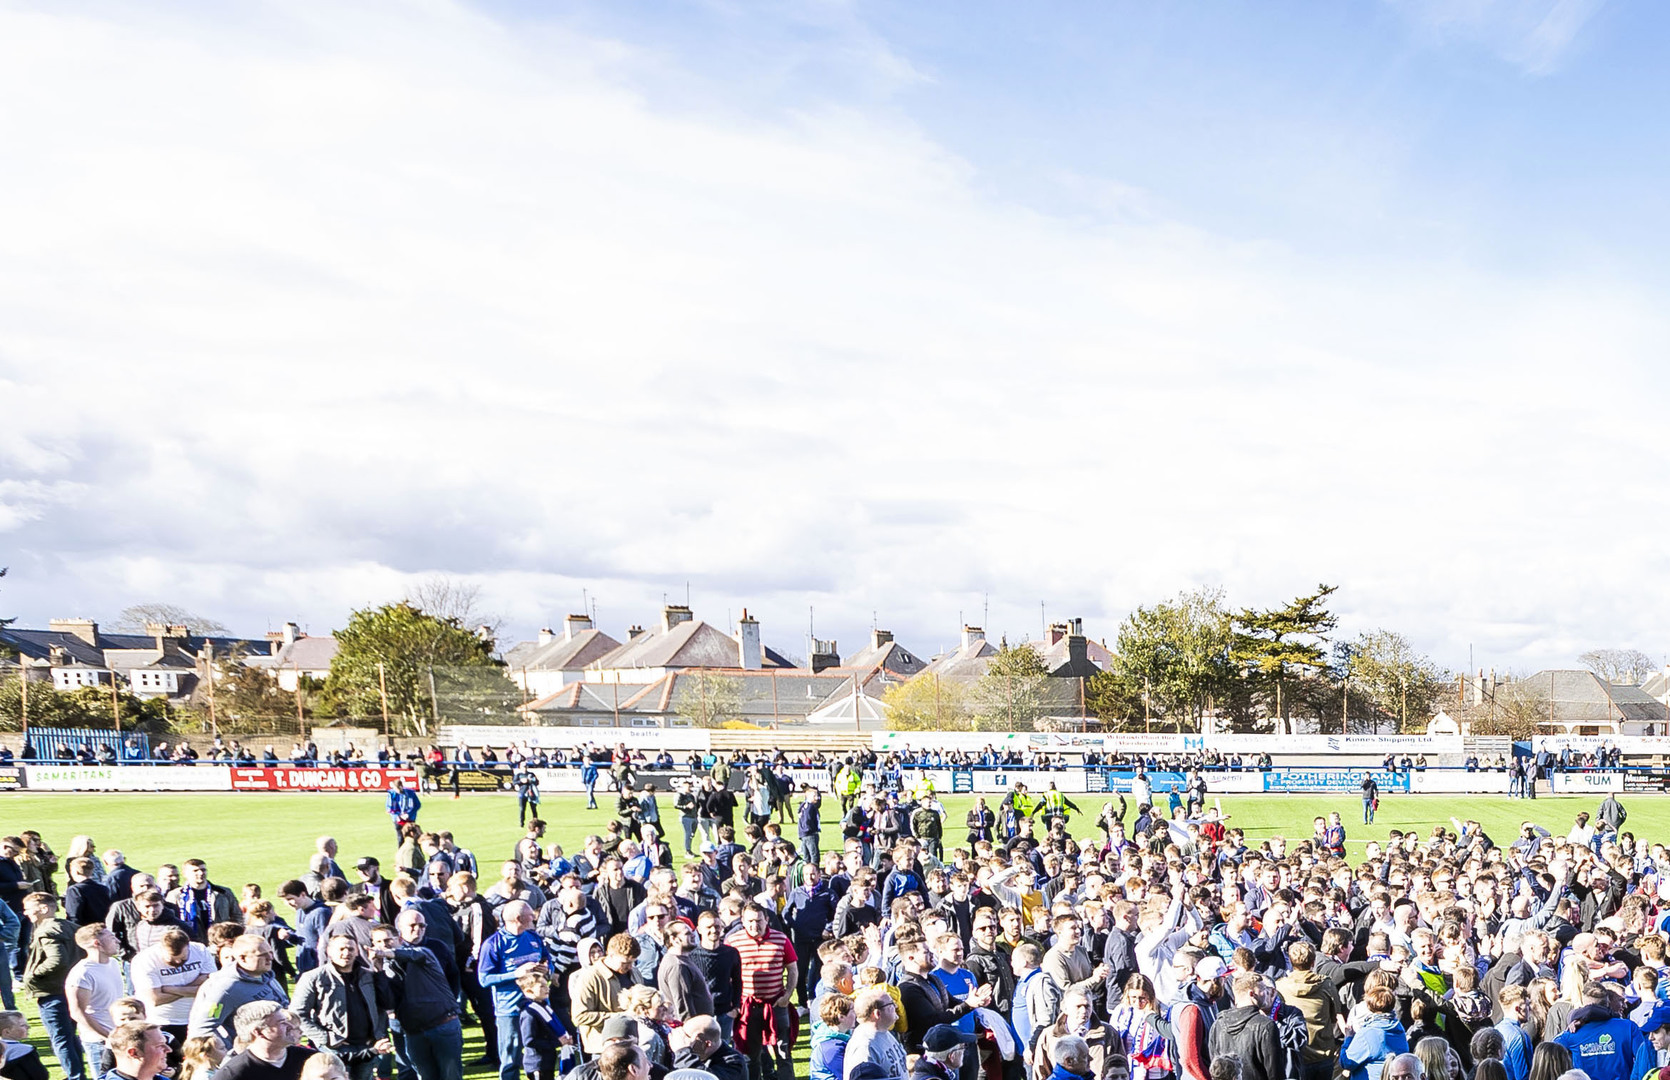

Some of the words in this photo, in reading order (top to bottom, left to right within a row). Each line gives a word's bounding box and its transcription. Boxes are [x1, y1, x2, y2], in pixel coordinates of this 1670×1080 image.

[36, 770, 113, 782] SAMARITANS
[274, 771, 287, 788] T.
[290, 771, 346, 788] DUNCAN
[348, 771, 359, 788] &
[361, 771, 382, 788] CO
